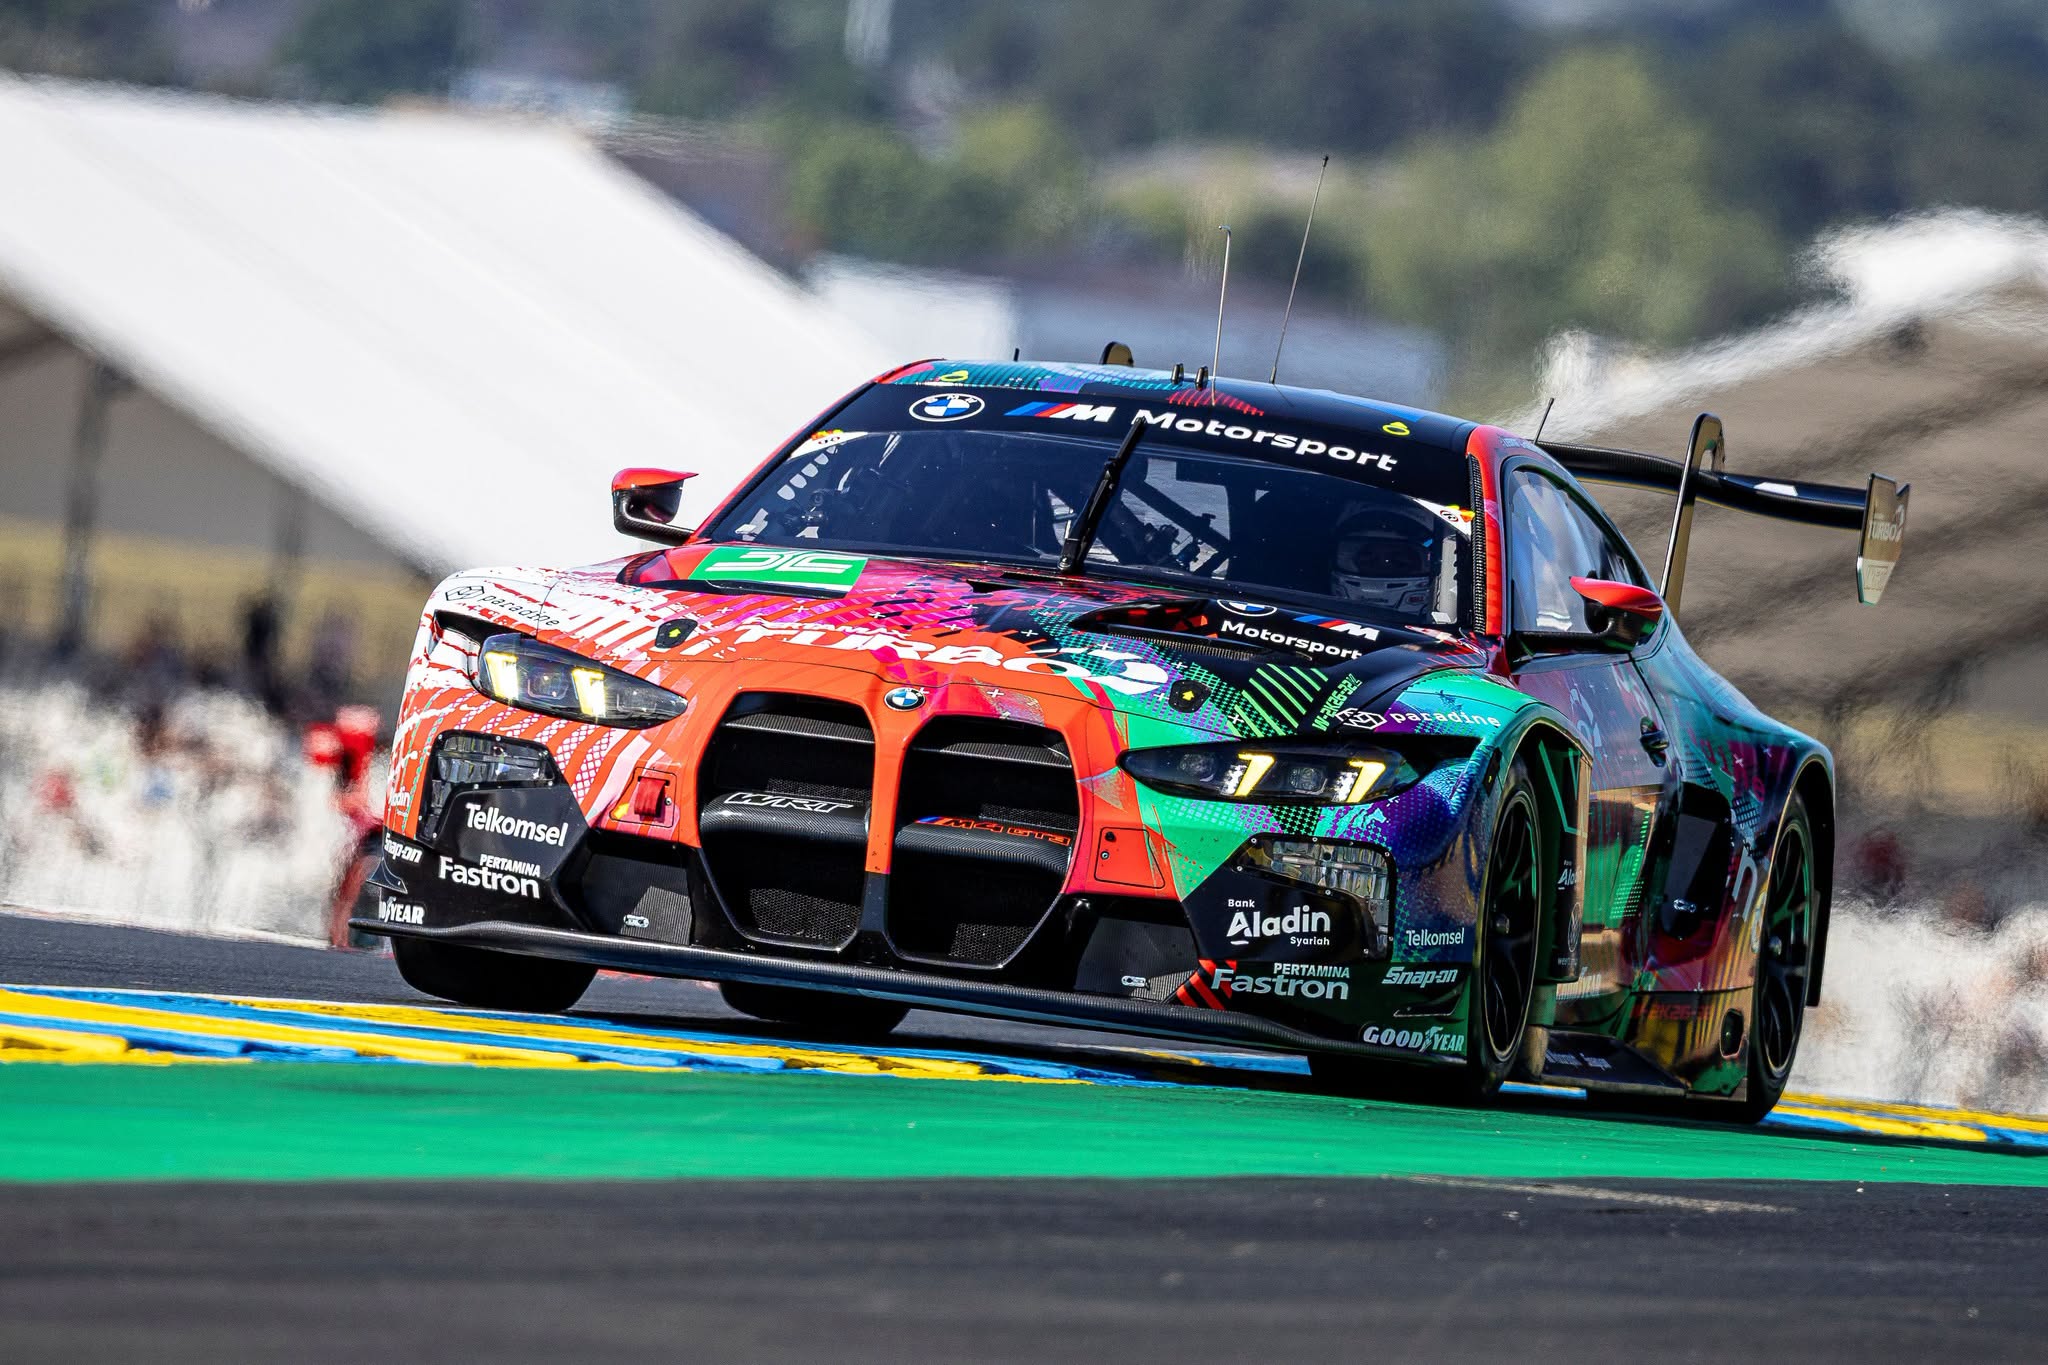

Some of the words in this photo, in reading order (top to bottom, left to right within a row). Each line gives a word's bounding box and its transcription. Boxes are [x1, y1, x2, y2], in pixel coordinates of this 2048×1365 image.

[1131, 409, 1398, 472] Motorsport
[477, 595, 560, 626] paradine
[1221, 620, 1363, 660] Motorsport
[1390, 712, 1501, 727] paradine
[466, 802, 568, 847] Telkomsel
[439, 855, 540, 899] Fastron
[480, 853, 541, 878] PERTAMINA
[1228, 899, 1255, 908] Bank
[1226, 905, 1331, 940] Aladin
[1290, 936, 1330, 947] Syariah
[1406, 927, 1465, 947] Telkomsel
[1211, 968, 1349, 1000] Fastron
[1273, 963, 1350, 978] PERTAMINA
[1382, 966, 1458, 988] Snap-on
[1363, 1026, 1465, 1053] GOODYEAR
